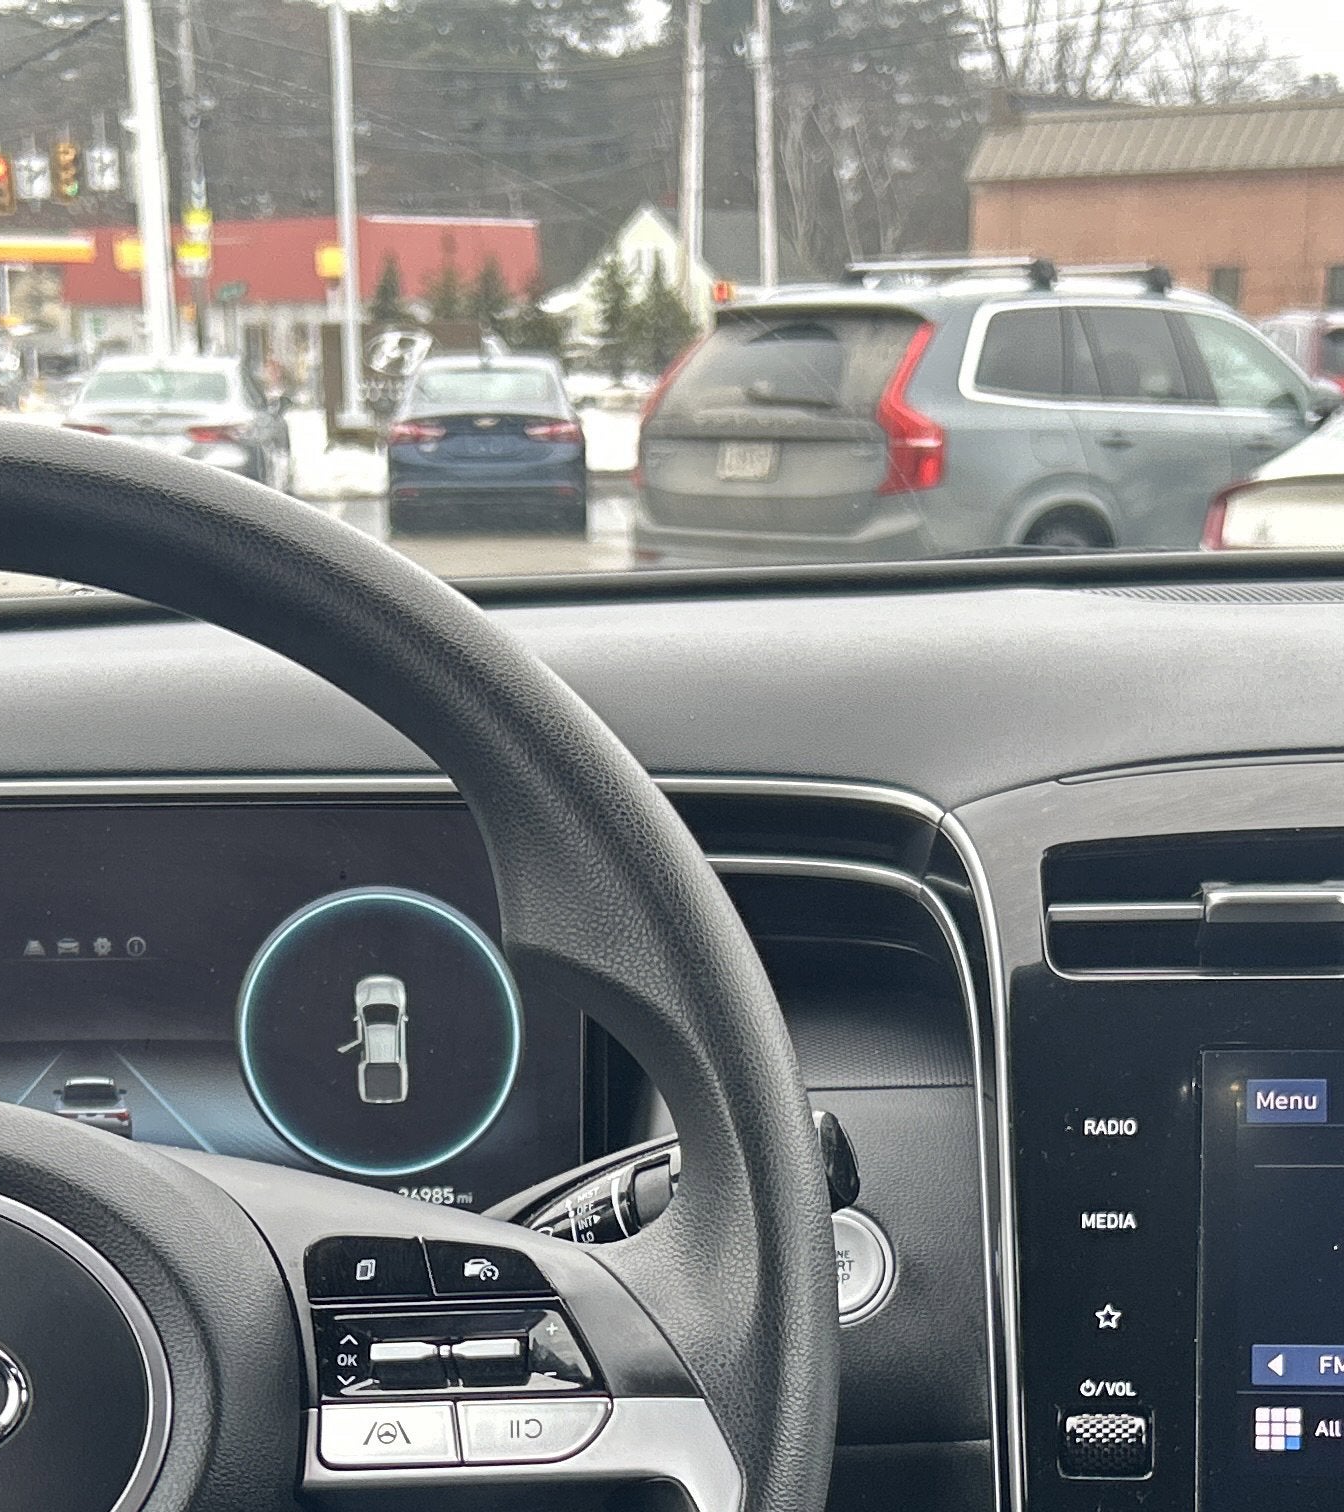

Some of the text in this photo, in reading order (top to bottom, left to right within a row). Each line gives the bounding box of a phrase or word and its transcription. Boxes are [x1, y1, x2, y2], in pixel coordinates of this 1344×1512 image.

[1256, 1090, 1318, 1111] Menu
[1083, 1119, 1137, 1136] RADIO
[456, 1192, 473, 1204] mi
[577, 1186, 600, 1204] MIST
[576, 1202, 594, 1215] OFF
[577, 1216, 594, 1230] INT
[1080, 1213, 1137, 1230] MEDIA
[580, 1230, 595, 1243] LO
[337, 1353, 357, 1367] OK
[1314, 1420, 1342, 1438] All
